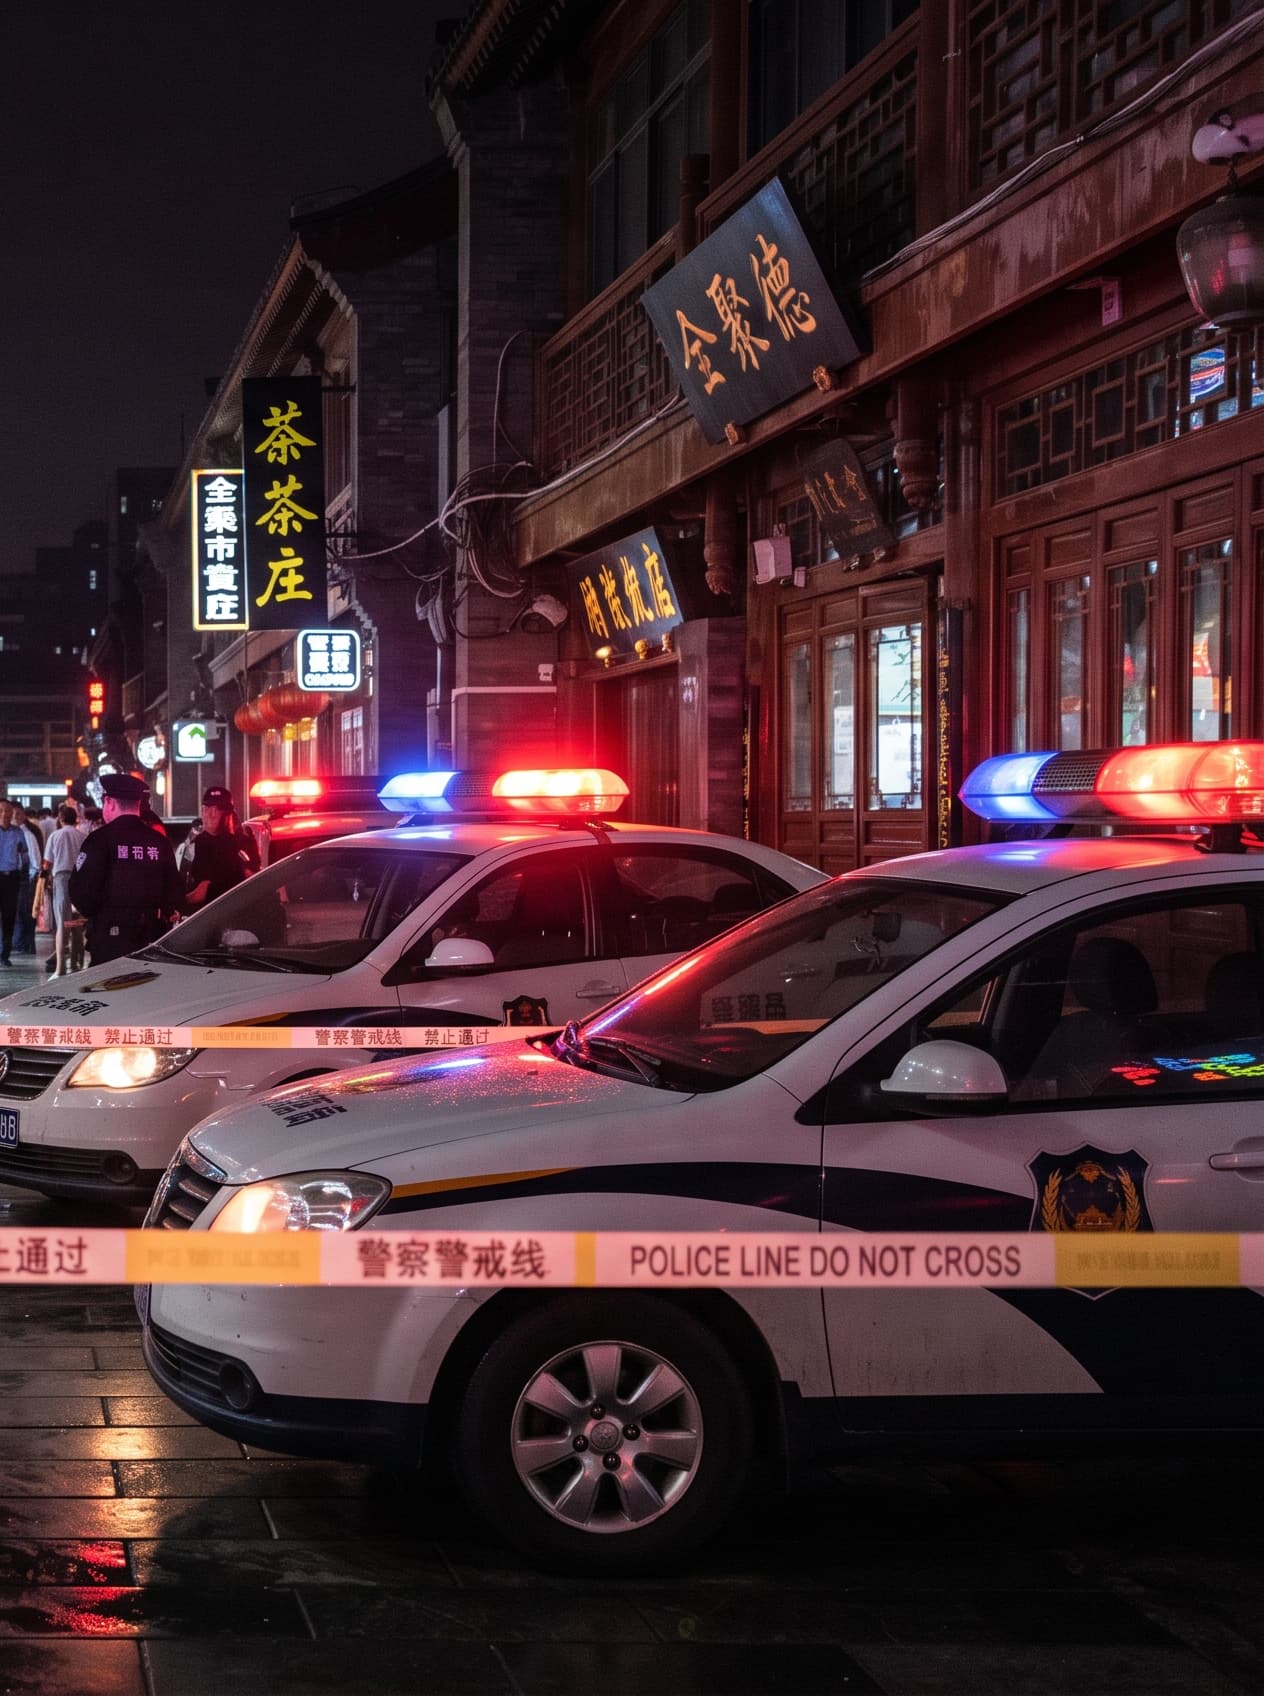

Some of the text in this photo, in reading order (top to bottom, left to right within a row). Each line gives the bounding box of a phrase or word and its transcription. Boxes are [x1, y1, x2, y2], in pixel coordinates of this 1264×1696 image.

[676, 233, 818, 396] 全聚德
[254, 400, 319, 608] 茶茶庄
[104, 1028, 173, 1045] 禁止通过
[357, 1238, 547, 1279] 警察警戒线
[630, 1245, 1022, 1277] POLICE LINE DO NOT CROSS
